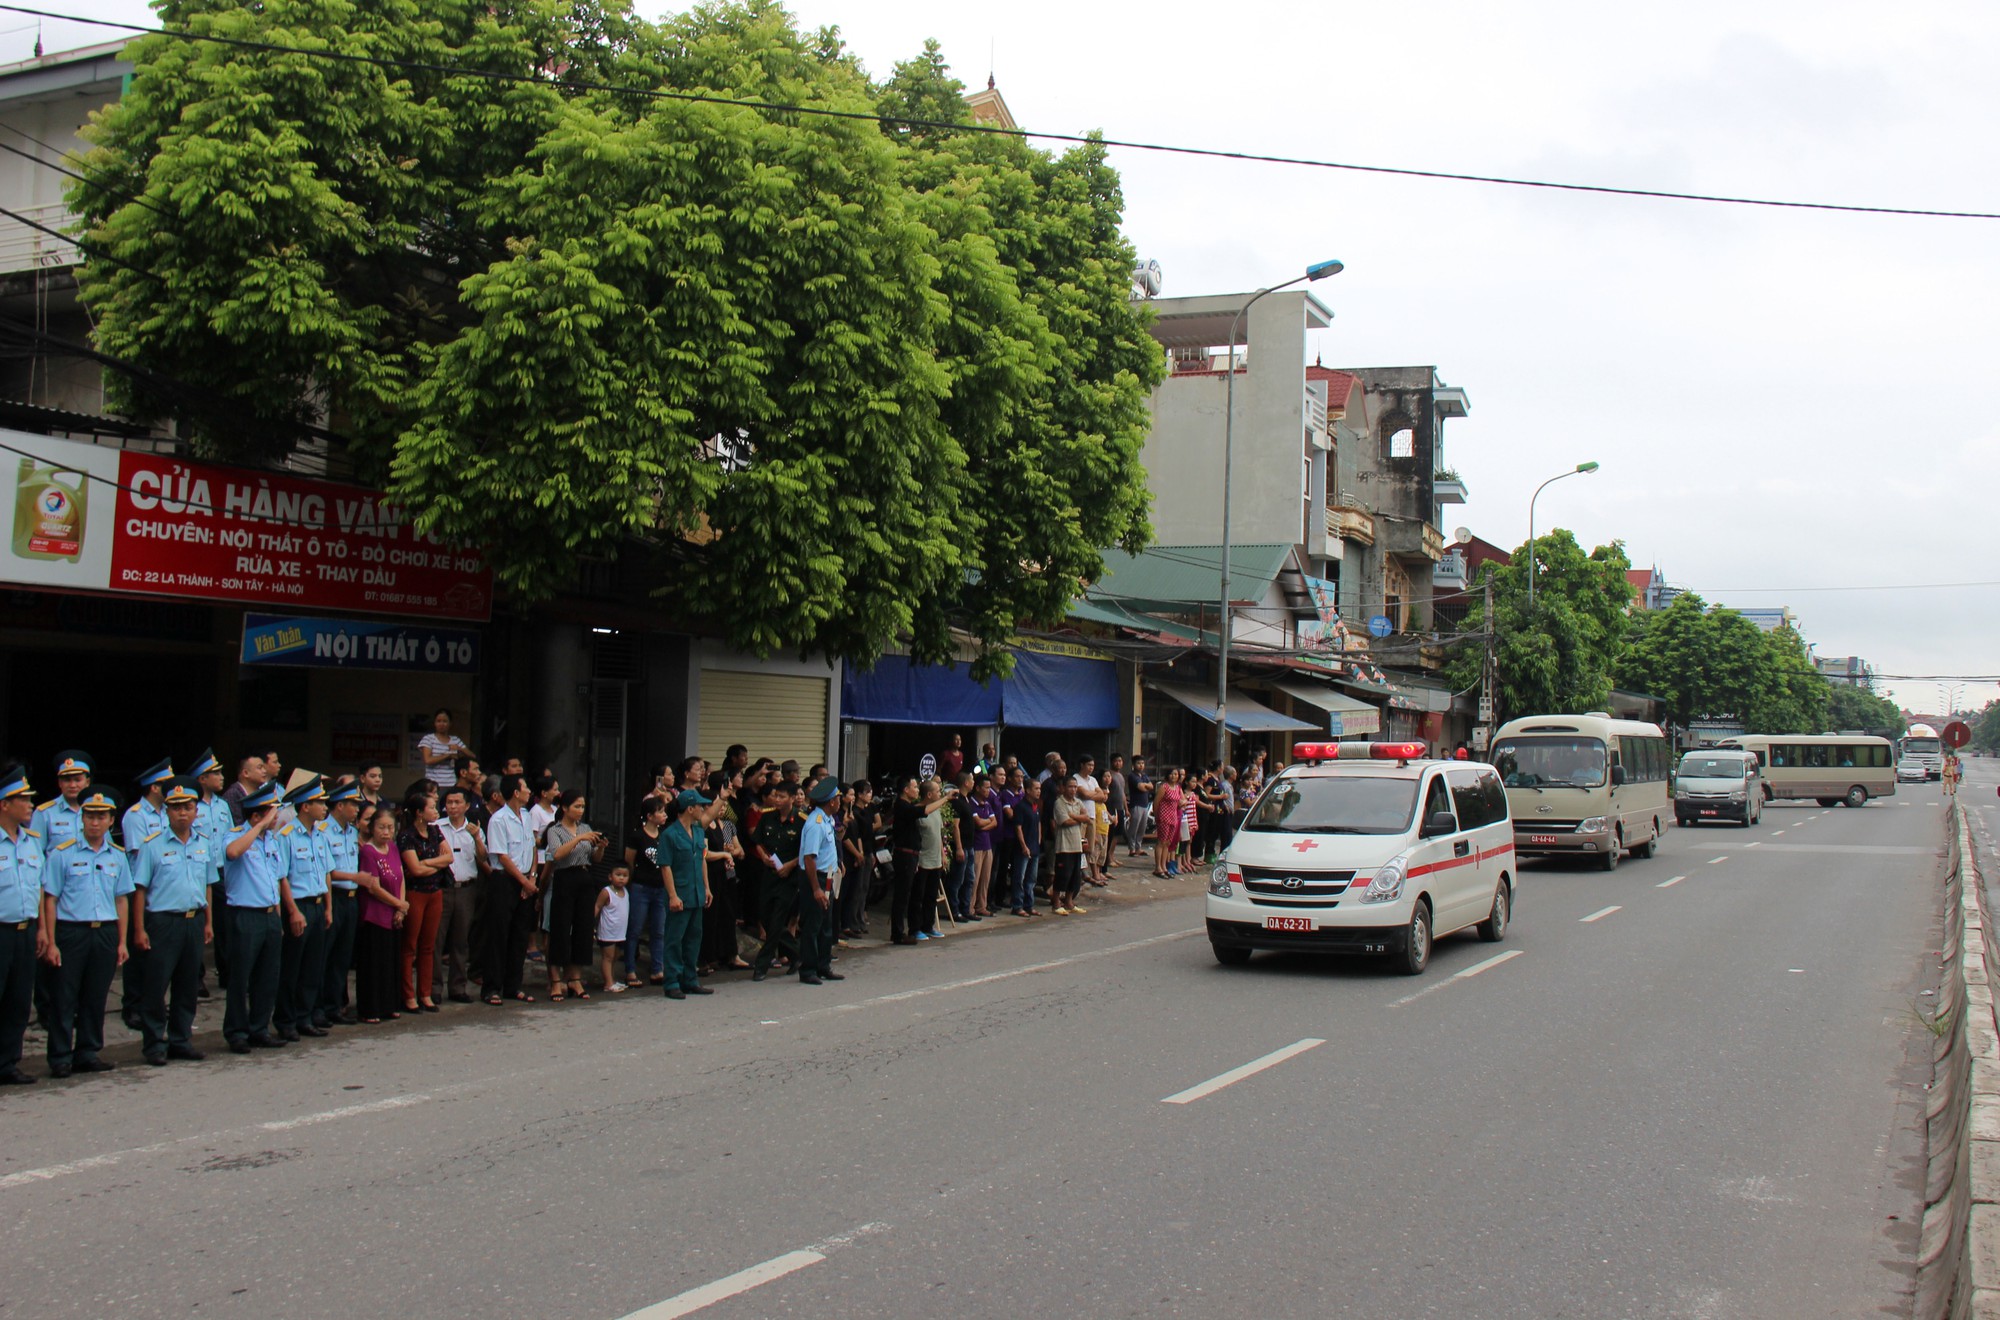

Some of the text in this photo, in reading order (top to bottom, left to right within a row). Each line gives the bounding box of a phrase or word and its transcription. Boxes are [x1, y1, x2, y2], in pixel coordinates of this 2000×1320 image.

[130, 464, 213, 517] CỬA
[224, 478, 325, 531] HÀNG
[336, 496, 400, 539] VĂN
[126, 518, 214, 544] CHUYÊN:
[219, 529, 253, 551] NỘI
[258, 531, 303, 553] THẤT
[307, 536, 320, 556] Ô
[325, 540, 348, 558] TÔ
[361, 543, 385, 563] ĐỒ
[389, 549, 428, 567] CHƠI
[432, 554, 450, 570] XE
[454, 558, 480, 574] HƠI
[122, 569, 142, 581] ĐC:
[145, 572, 159, 582] 22
[161, 572, 175, 584] LA
[177, 572, 213, 587] THÀNH
[221, 576, 241, 590] SƠN
[245, 579, 264, 591] TÂY
[271, 582, 286, 593] HÀ
[287, 583, 304, 596] NỘI
[278, 560, 301, 577] XE
[316, 564, 359, 583] THAY
[362, 565, 396, 587] DẦU
[314, 629, 472, 664] NỘI THẤT Ô TÔ
